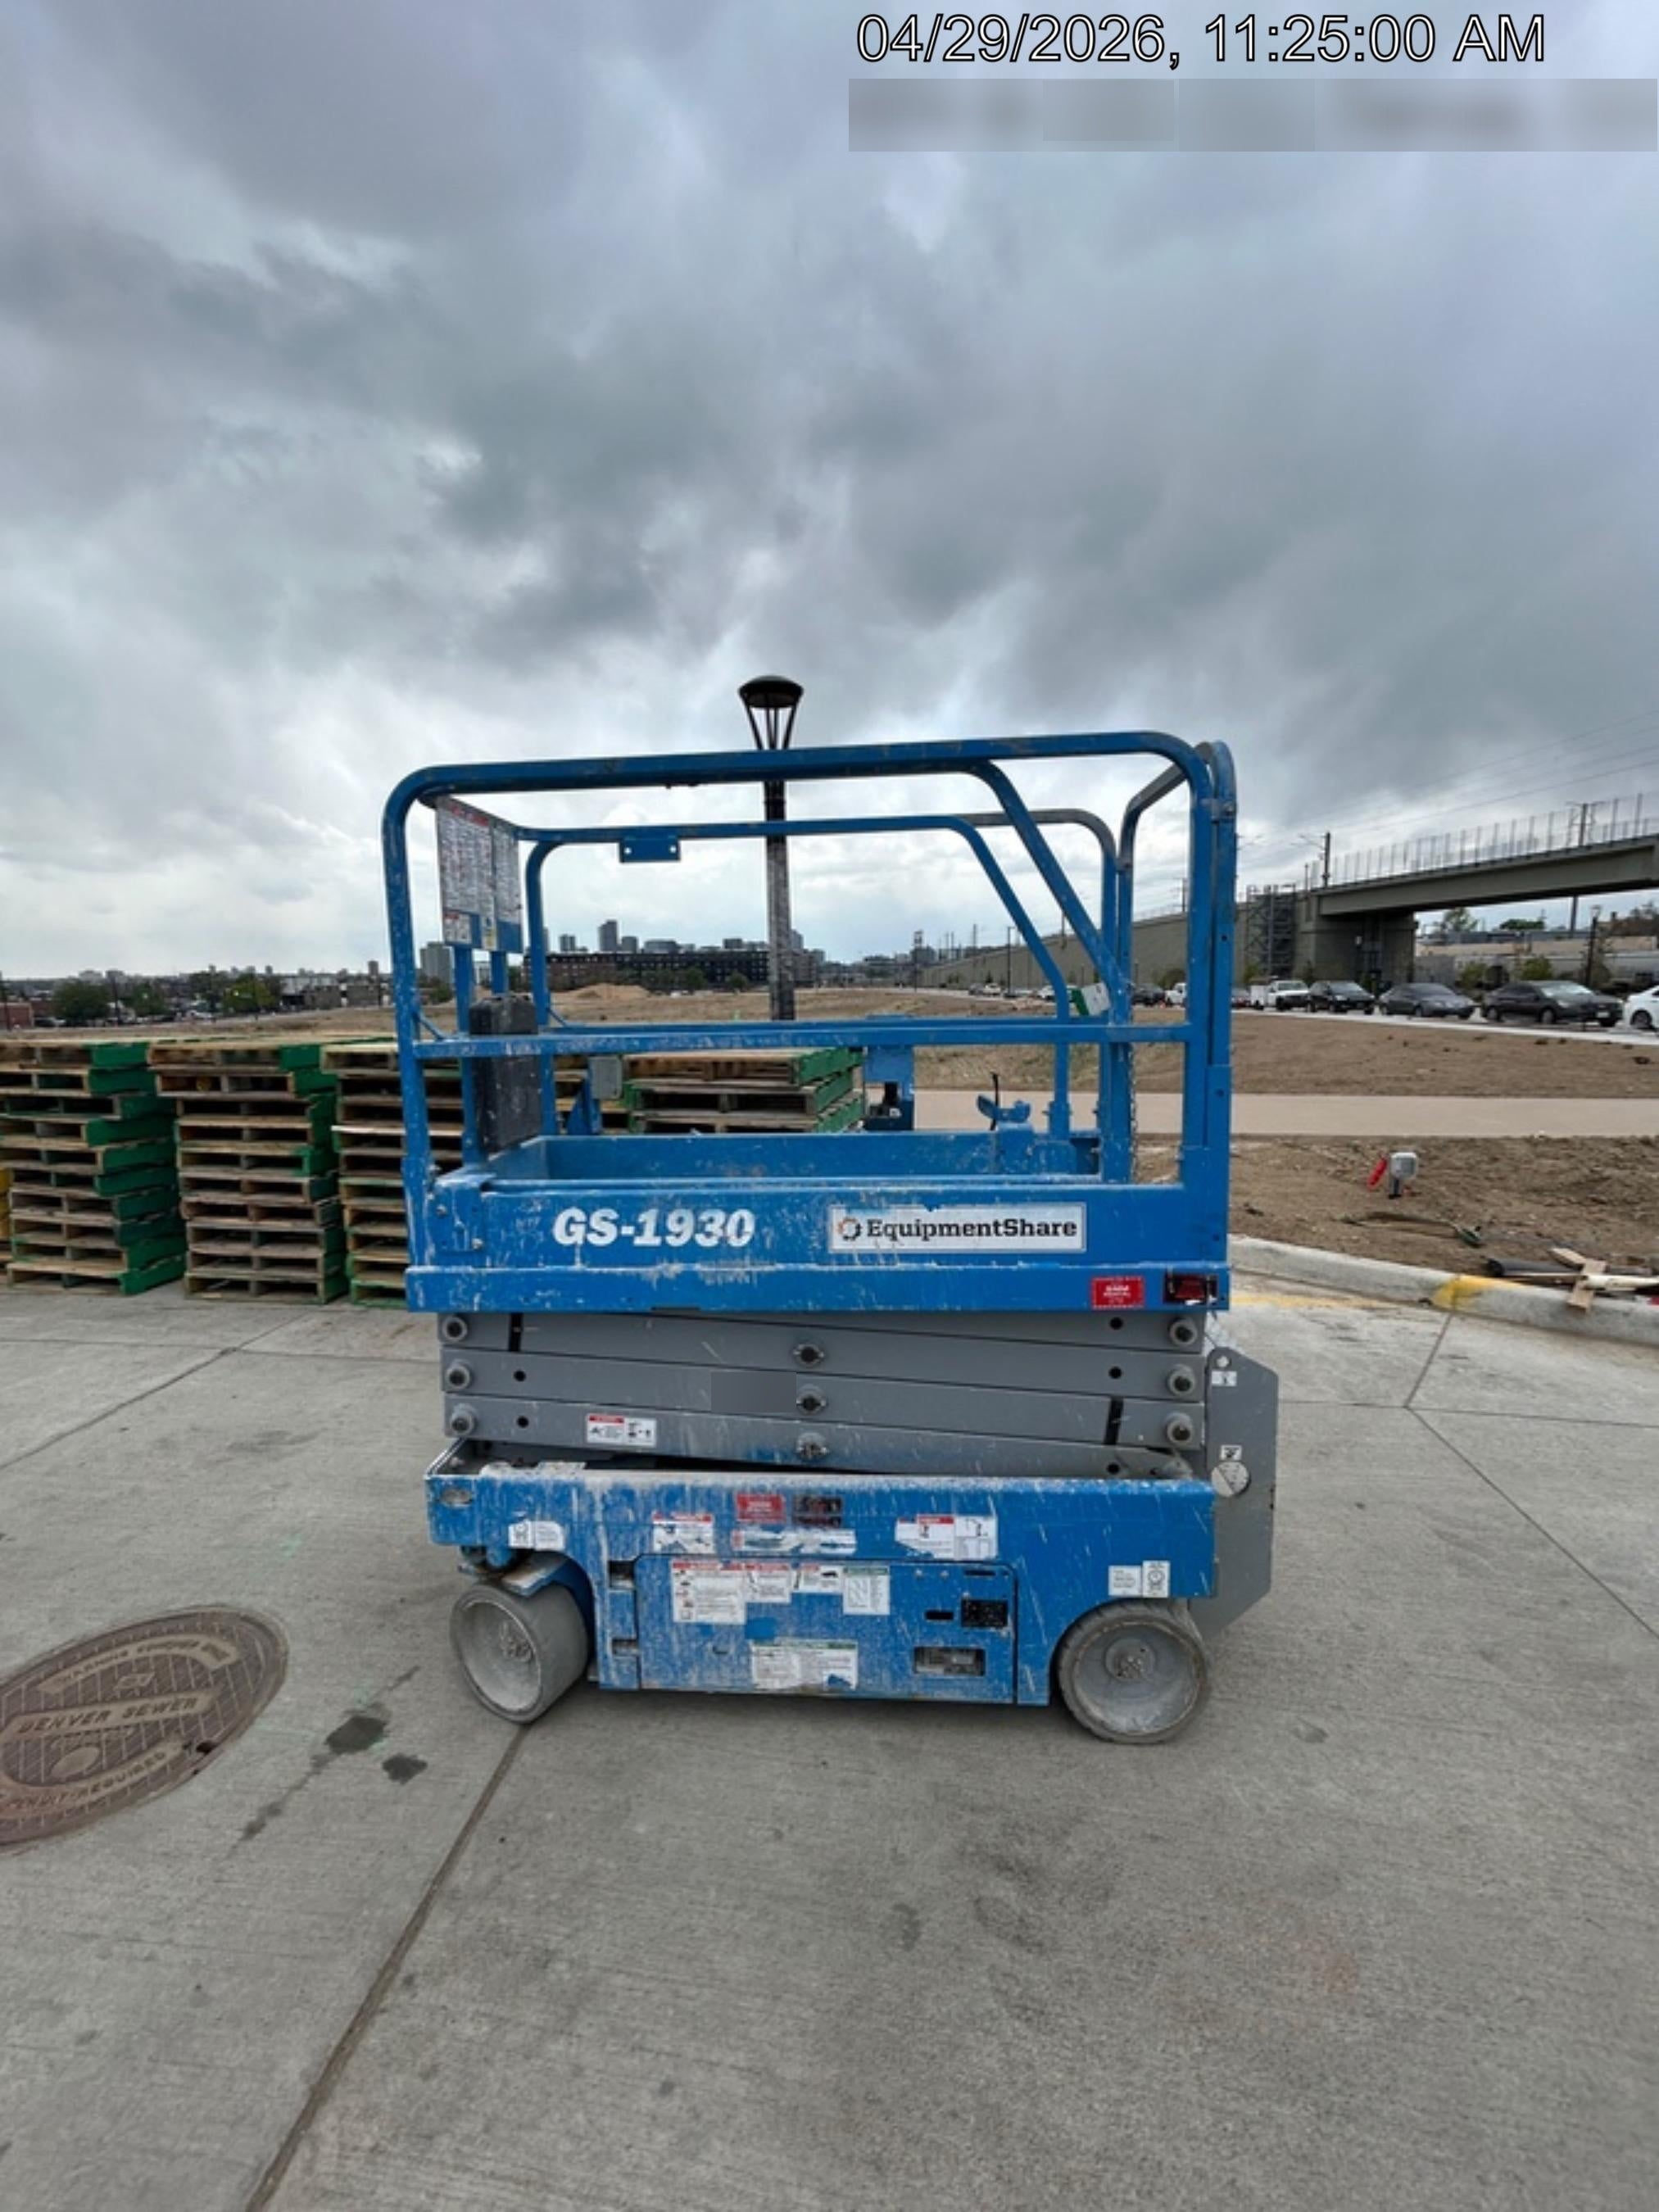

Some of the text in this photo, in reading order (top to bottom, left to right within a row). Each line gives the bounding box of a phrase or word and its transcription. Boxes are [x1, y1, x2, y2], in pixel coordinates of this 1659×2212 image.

[552, 1207, 755, 1247] GS-1930
[866, 1217, 1077, 1241] EquipmentShare
[16, 1697, 197, 1734] DENVER SEWER
